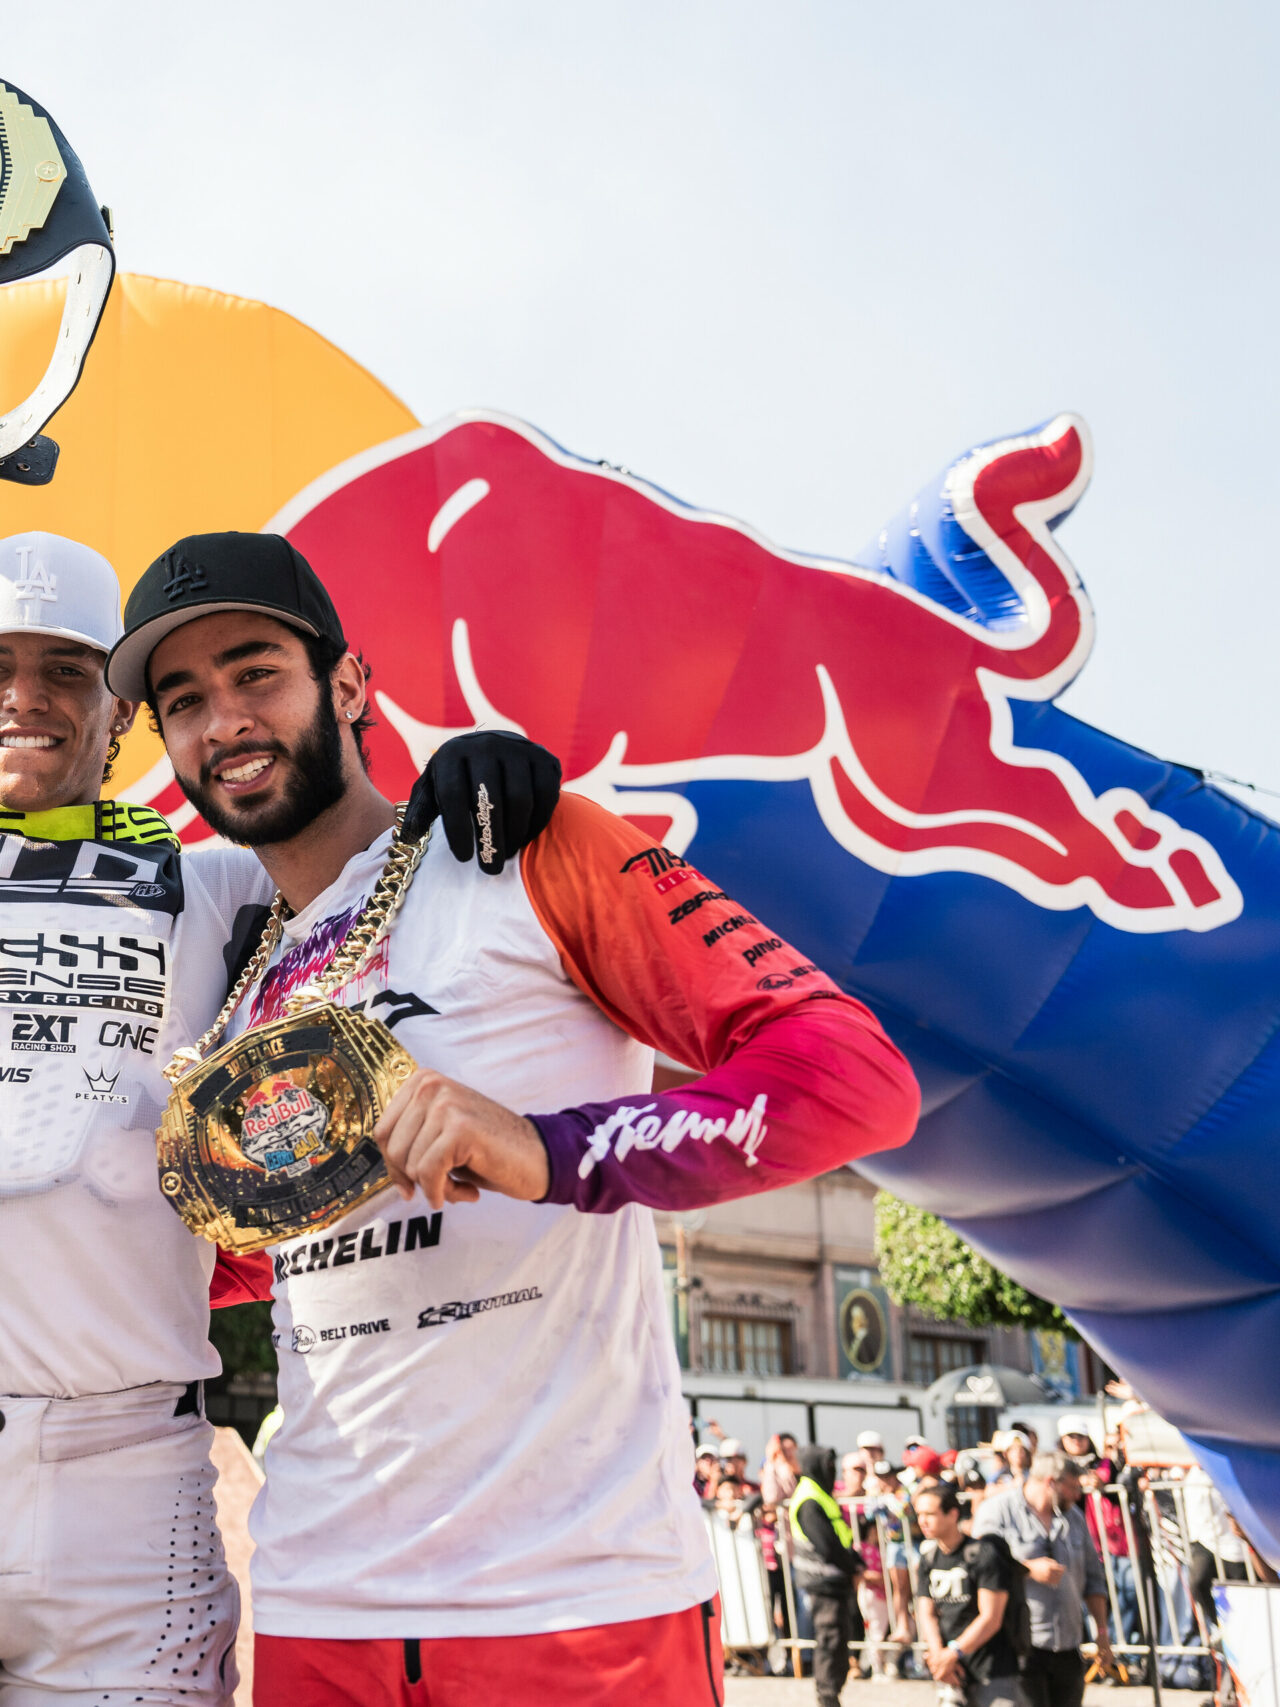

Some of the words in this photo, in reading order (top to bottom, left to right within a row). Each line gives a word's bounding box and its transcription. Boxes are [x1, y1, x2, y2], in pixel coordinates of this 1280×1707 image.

[14, 546, 58, 603] LA
[159, 547, 209, 600] LA
[43, 994, 160, 1015] RACING
[12, 1013, 78, 1043] EXT
[13, 1043, 47, 1051] RACING
[50, 1044, 75, 1053] SHOX
[224, 1054, 247, 1079] 3RD
[247, 1037, 286, 1061] PLACE
[75, 1092, 128, 1104] PEATY'S
[244, 1110, 278, 1137] Red
[277, 1091, 311, 1120] Bull
[320, 1326, 347, 1342] BELT
[350, 1318, 391, 1337] DRIVE
[453, 1286, 543, 1316] RENTHAL
